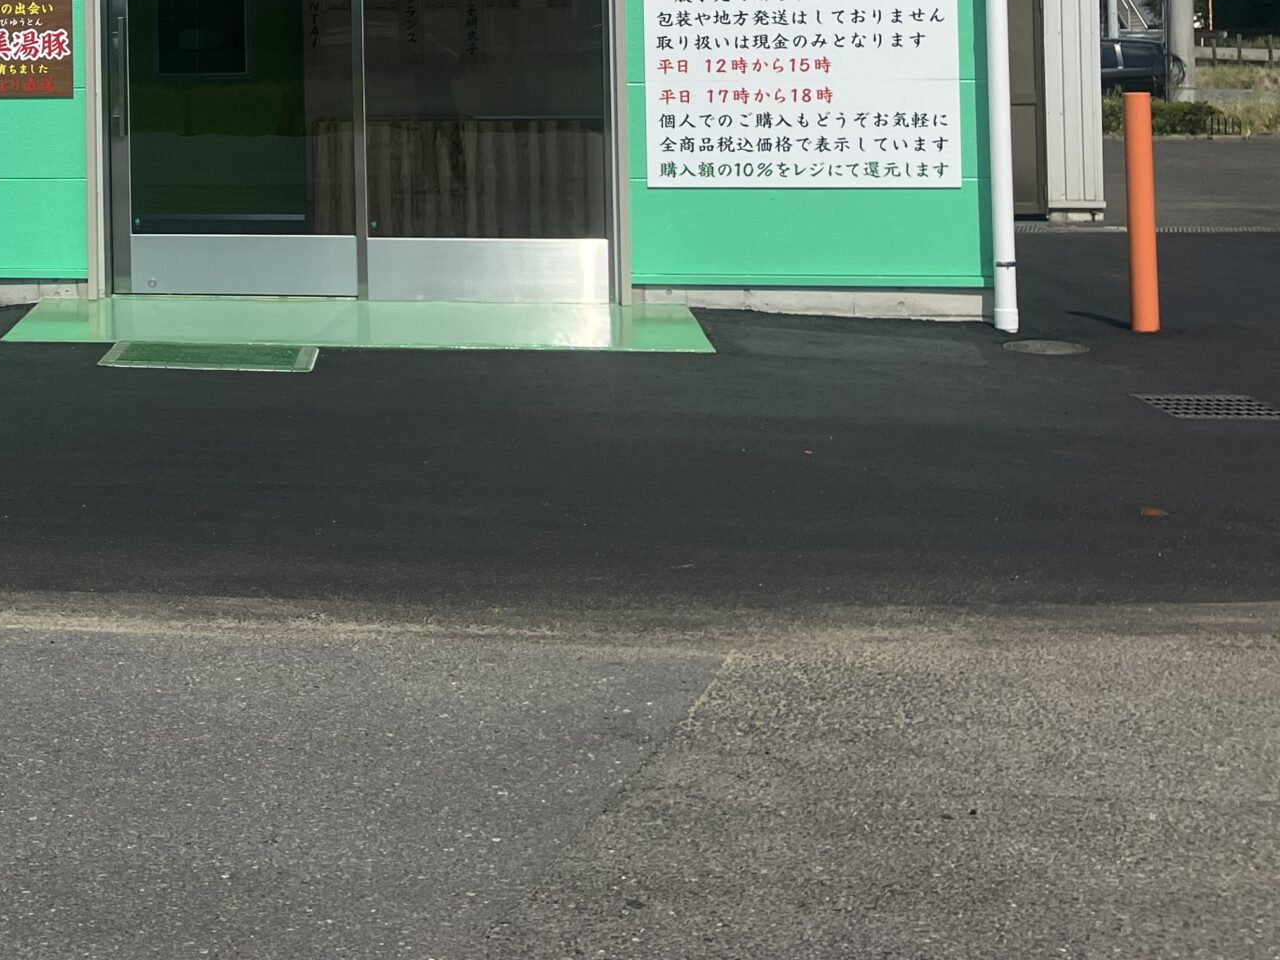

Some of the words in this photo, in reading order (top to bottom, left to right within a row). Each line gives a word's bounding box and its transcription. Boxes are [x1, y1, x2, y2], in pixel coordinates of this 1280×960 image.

[656, 8, 946, 27] 包装や地方発送はしておりません
[656, 32, 926, 51] 取り扱いは現金のみとなります
[657, 58, 689, 75] 平日
[705, 56, 832, 74] 12時から15時
[659, 89, 691, 106] 平日
[706, 86, 834, 105] 17時から18時
[659, 111, 949, 129] 個人でのご購入もどうぞお気軽に
[659, 136, 949, 153] 全商品税込価格で表示しています
[659, 160, 949, 178] 購入額の10%をレジにて還元します
